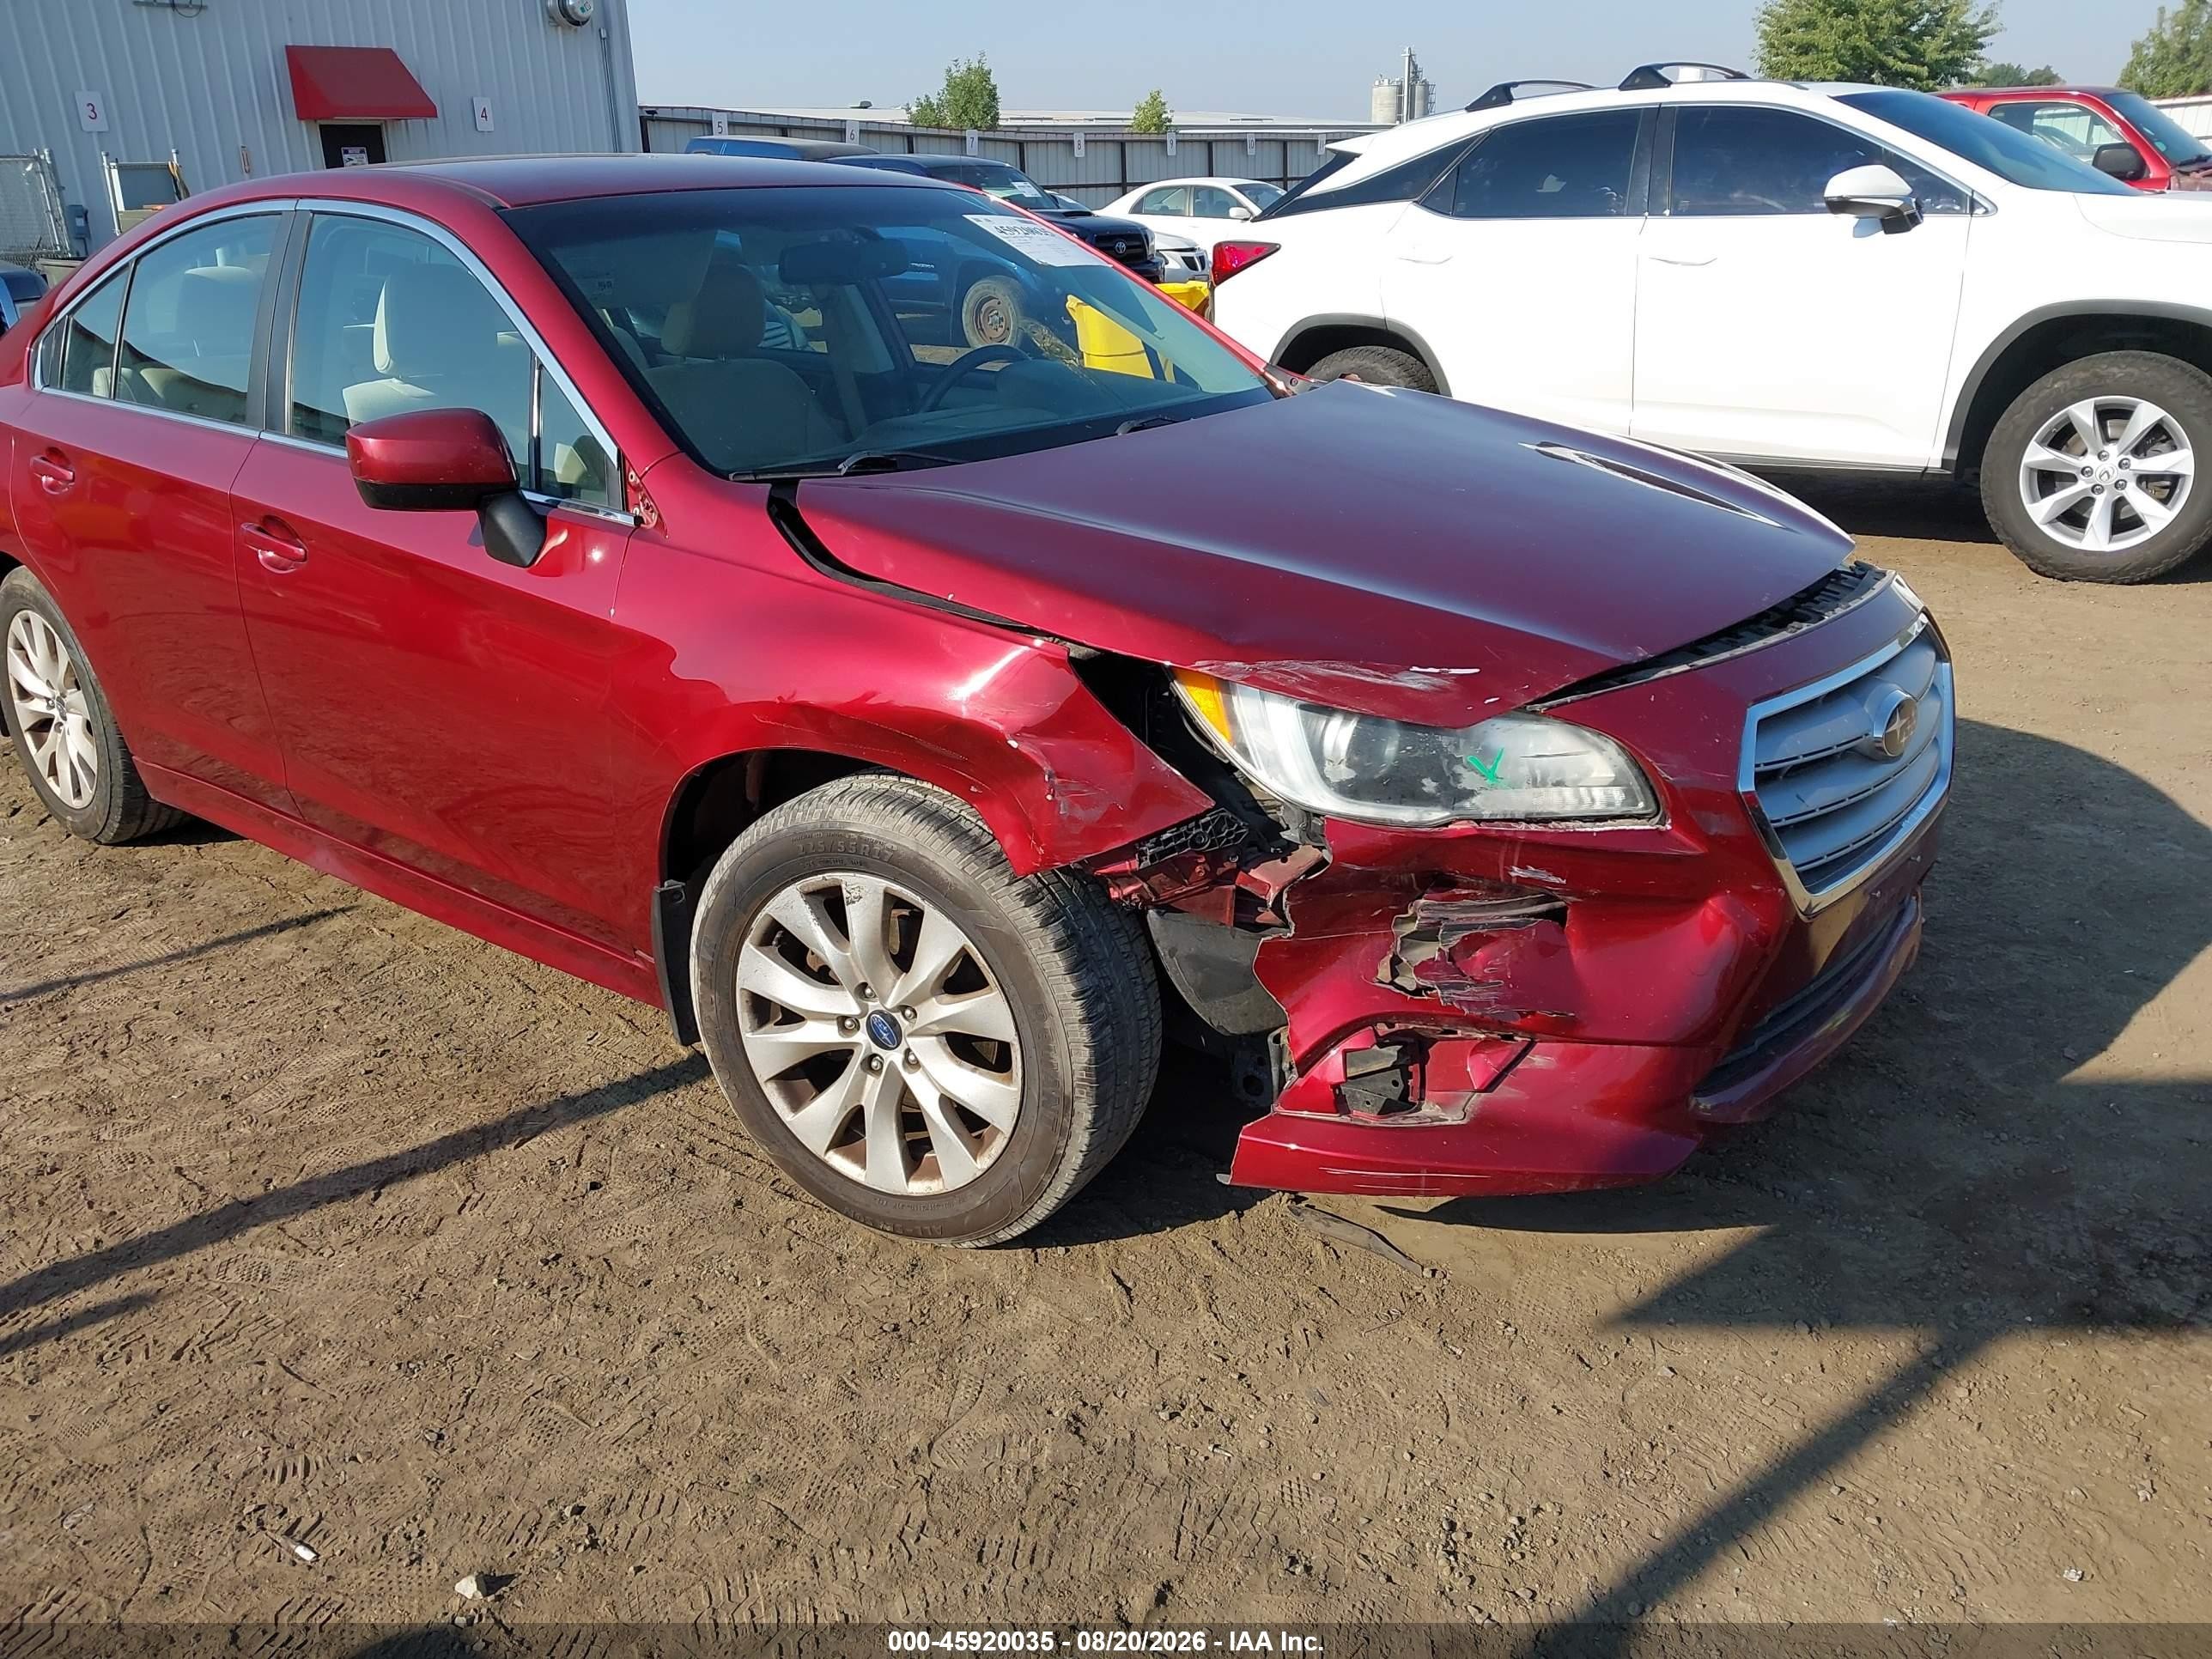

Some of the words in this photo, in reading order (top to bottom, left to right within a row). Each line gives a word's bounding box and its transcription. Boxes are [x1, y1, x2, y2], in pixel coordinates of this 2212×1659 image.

[87, 103, 97, 119] 3
[481, 107, 488, 121] 4
[717, 121, 723, 134] 5
[849, 129, 855, 141] 6
[969, 137, 975, 149] 7
[1077, 139, 1082, 150] 8
[1170, 139, 1174, 149] 9
[1248, 139, 1254, 149] 10
